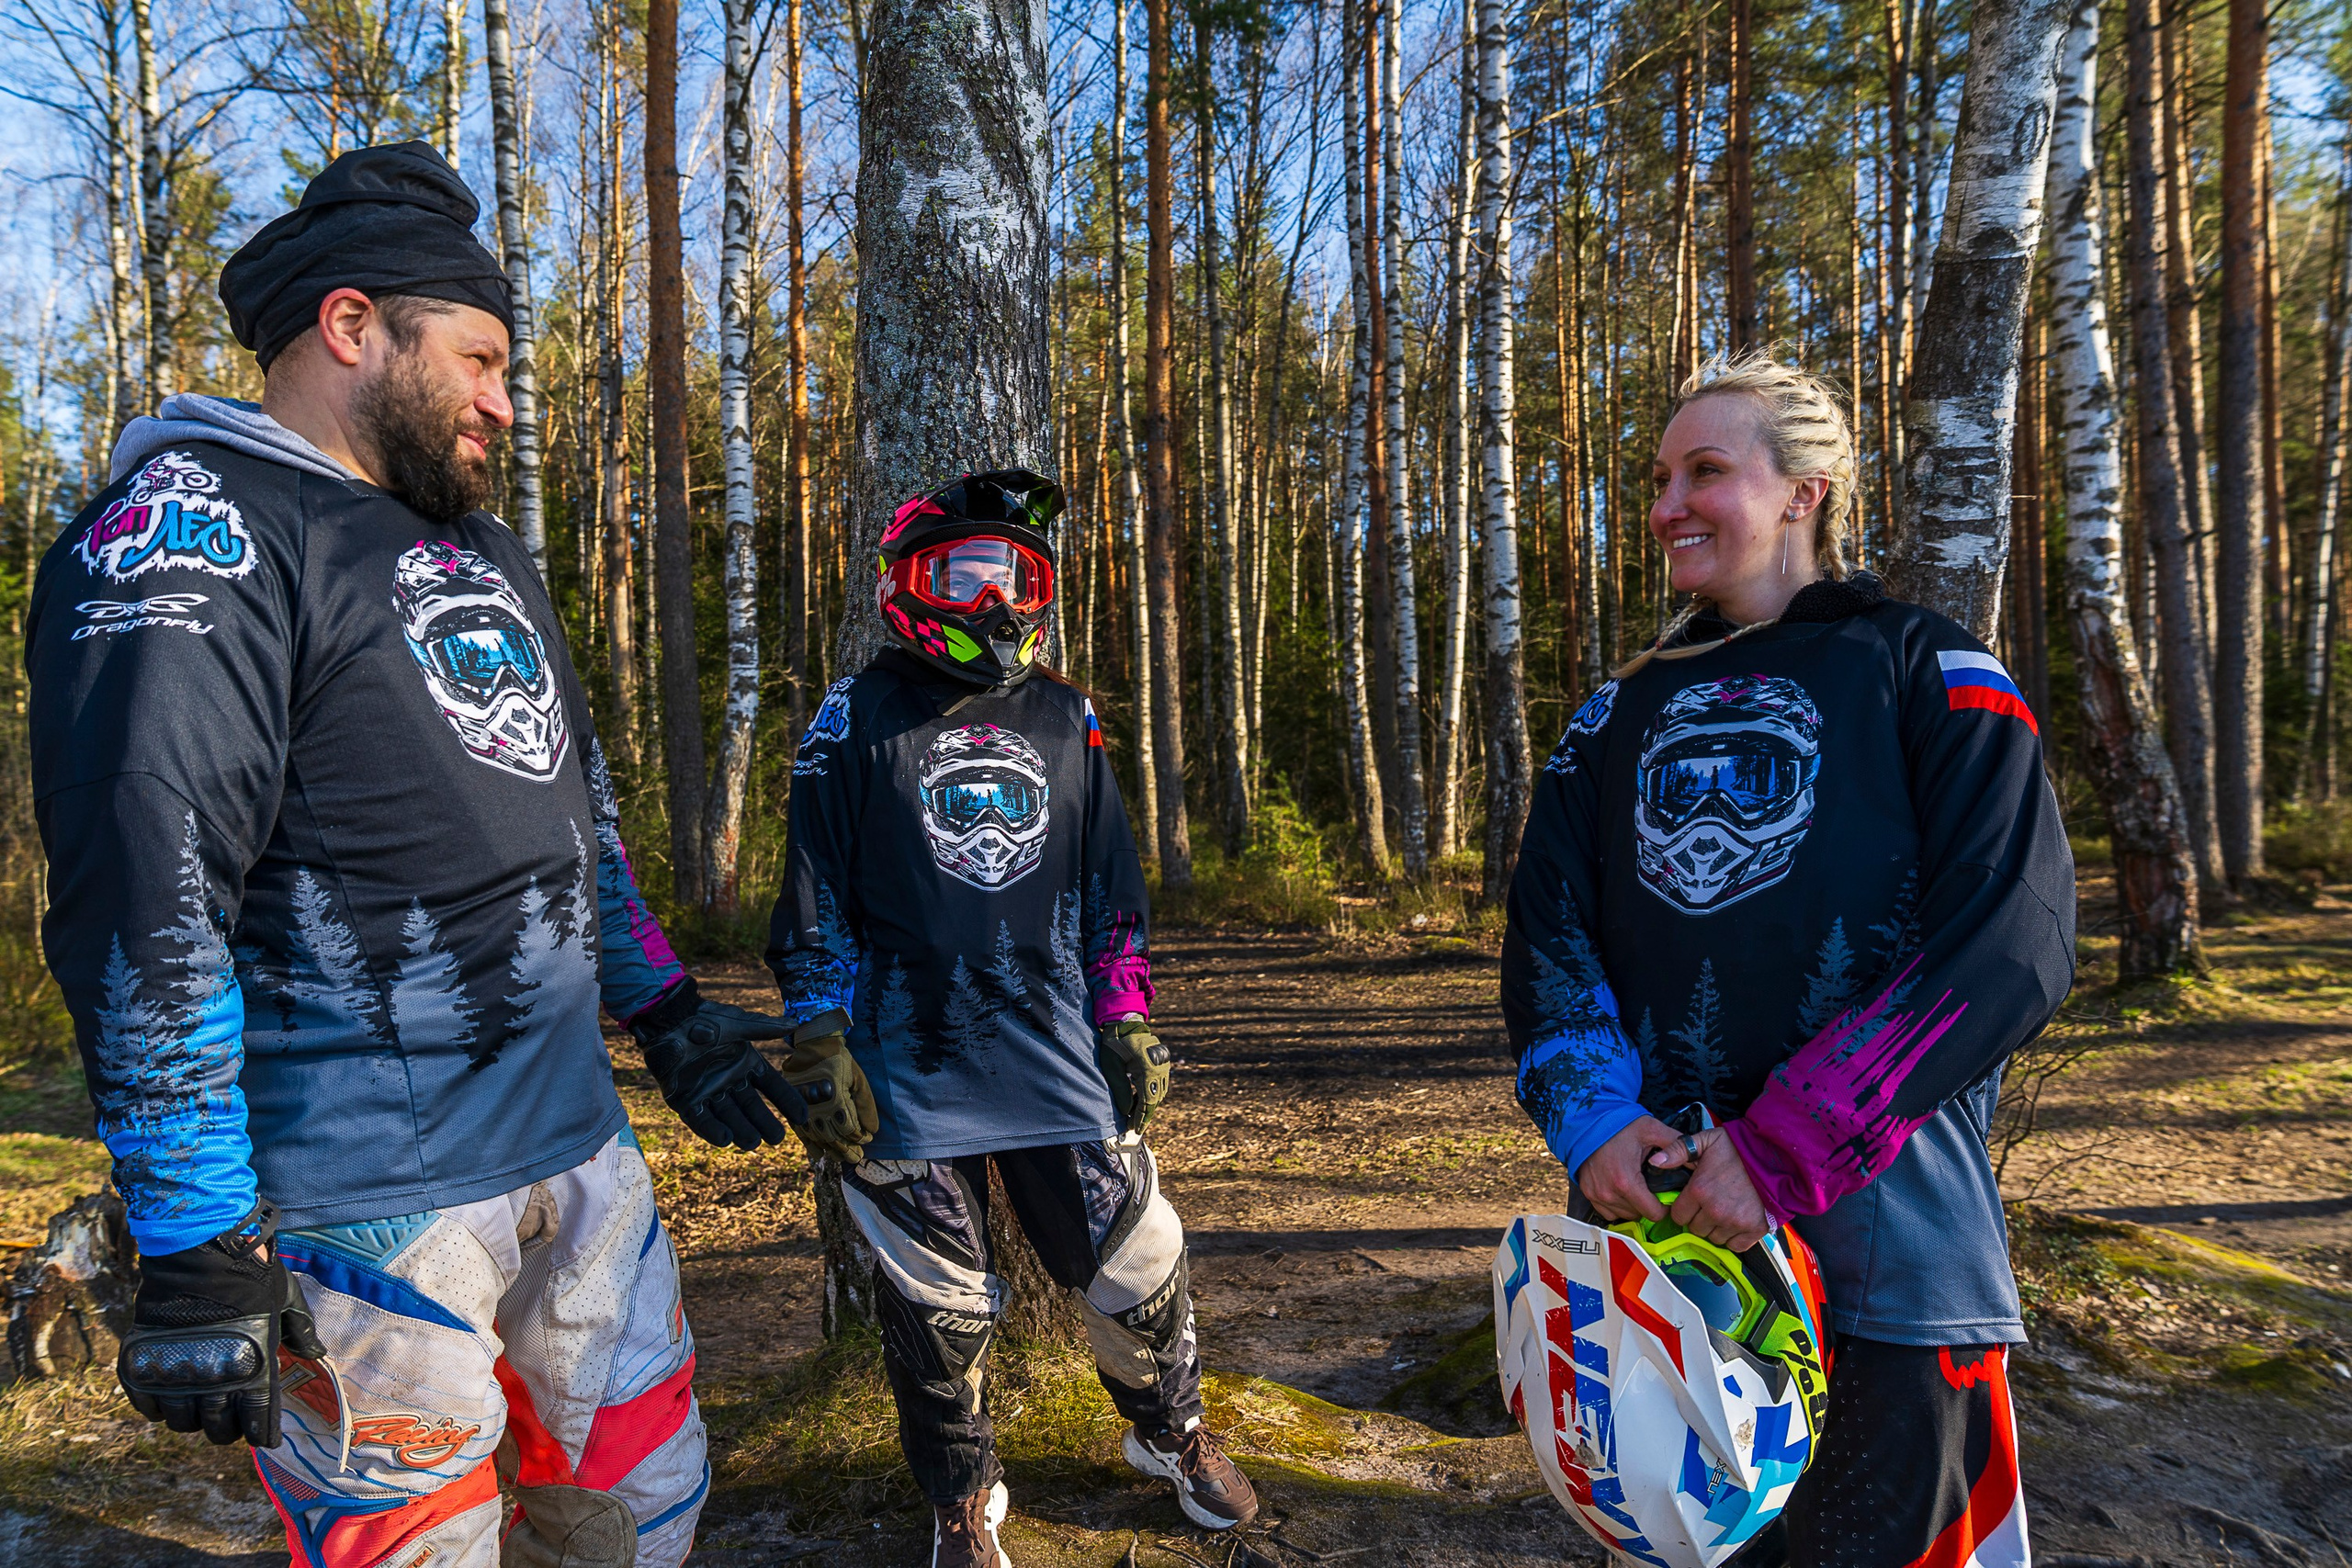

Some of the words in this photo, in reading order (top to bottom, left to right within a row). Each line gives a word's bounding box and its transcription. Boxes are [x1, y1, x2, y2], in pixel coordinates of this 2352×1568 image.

[1126, 1269, 1180, 1326] thor
[927, 1311, 992, 1334] thor
[350, 1413, 481, 1469] Racing
[1706, 1457, 1727, 1495] NEX
